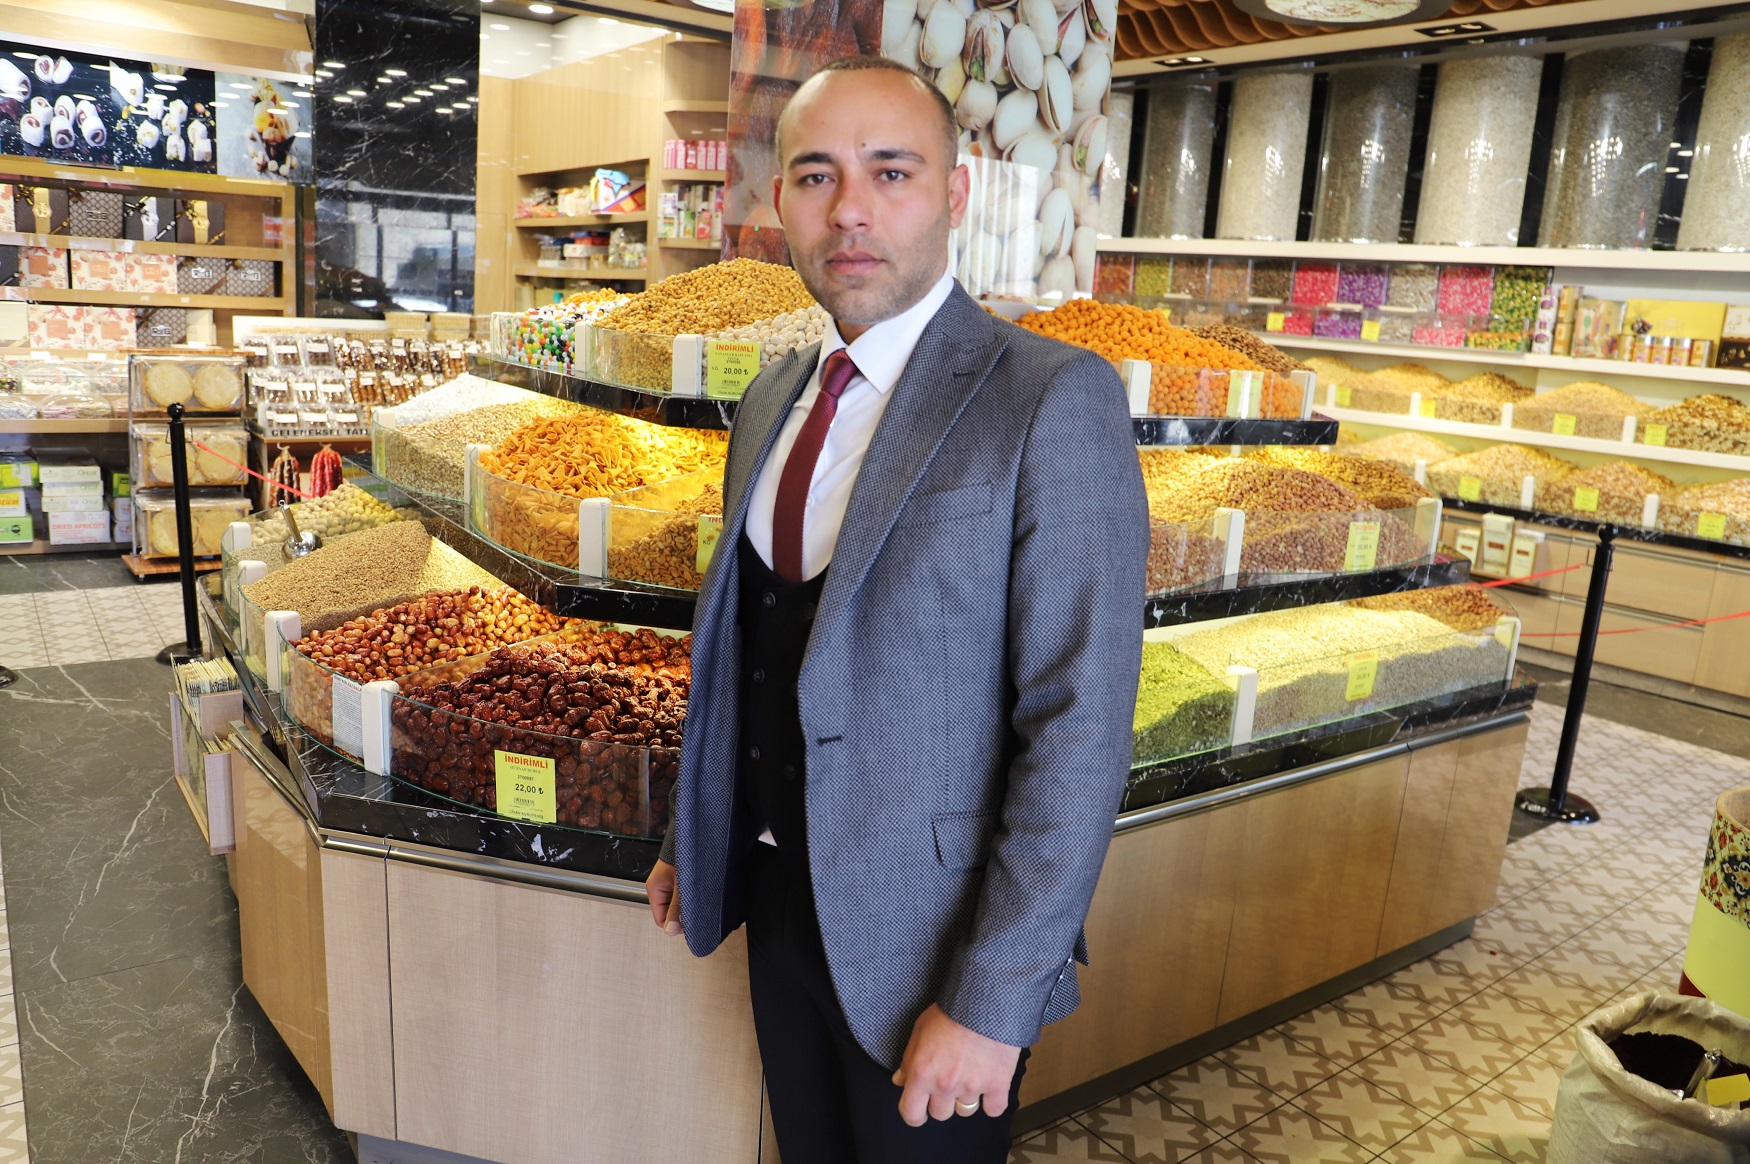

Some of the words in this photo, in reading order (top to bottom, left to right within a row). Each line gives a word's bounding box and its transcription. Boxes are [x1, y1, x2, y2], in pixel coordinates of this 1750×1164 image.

[716, 343, 754, 352] İNDİRİMLİ
[74, 522, 106, 530] APRICOTS
[504, 753, 548, 768] İNDİRİMLİ
[515, 783, 536, 793] 22,00
